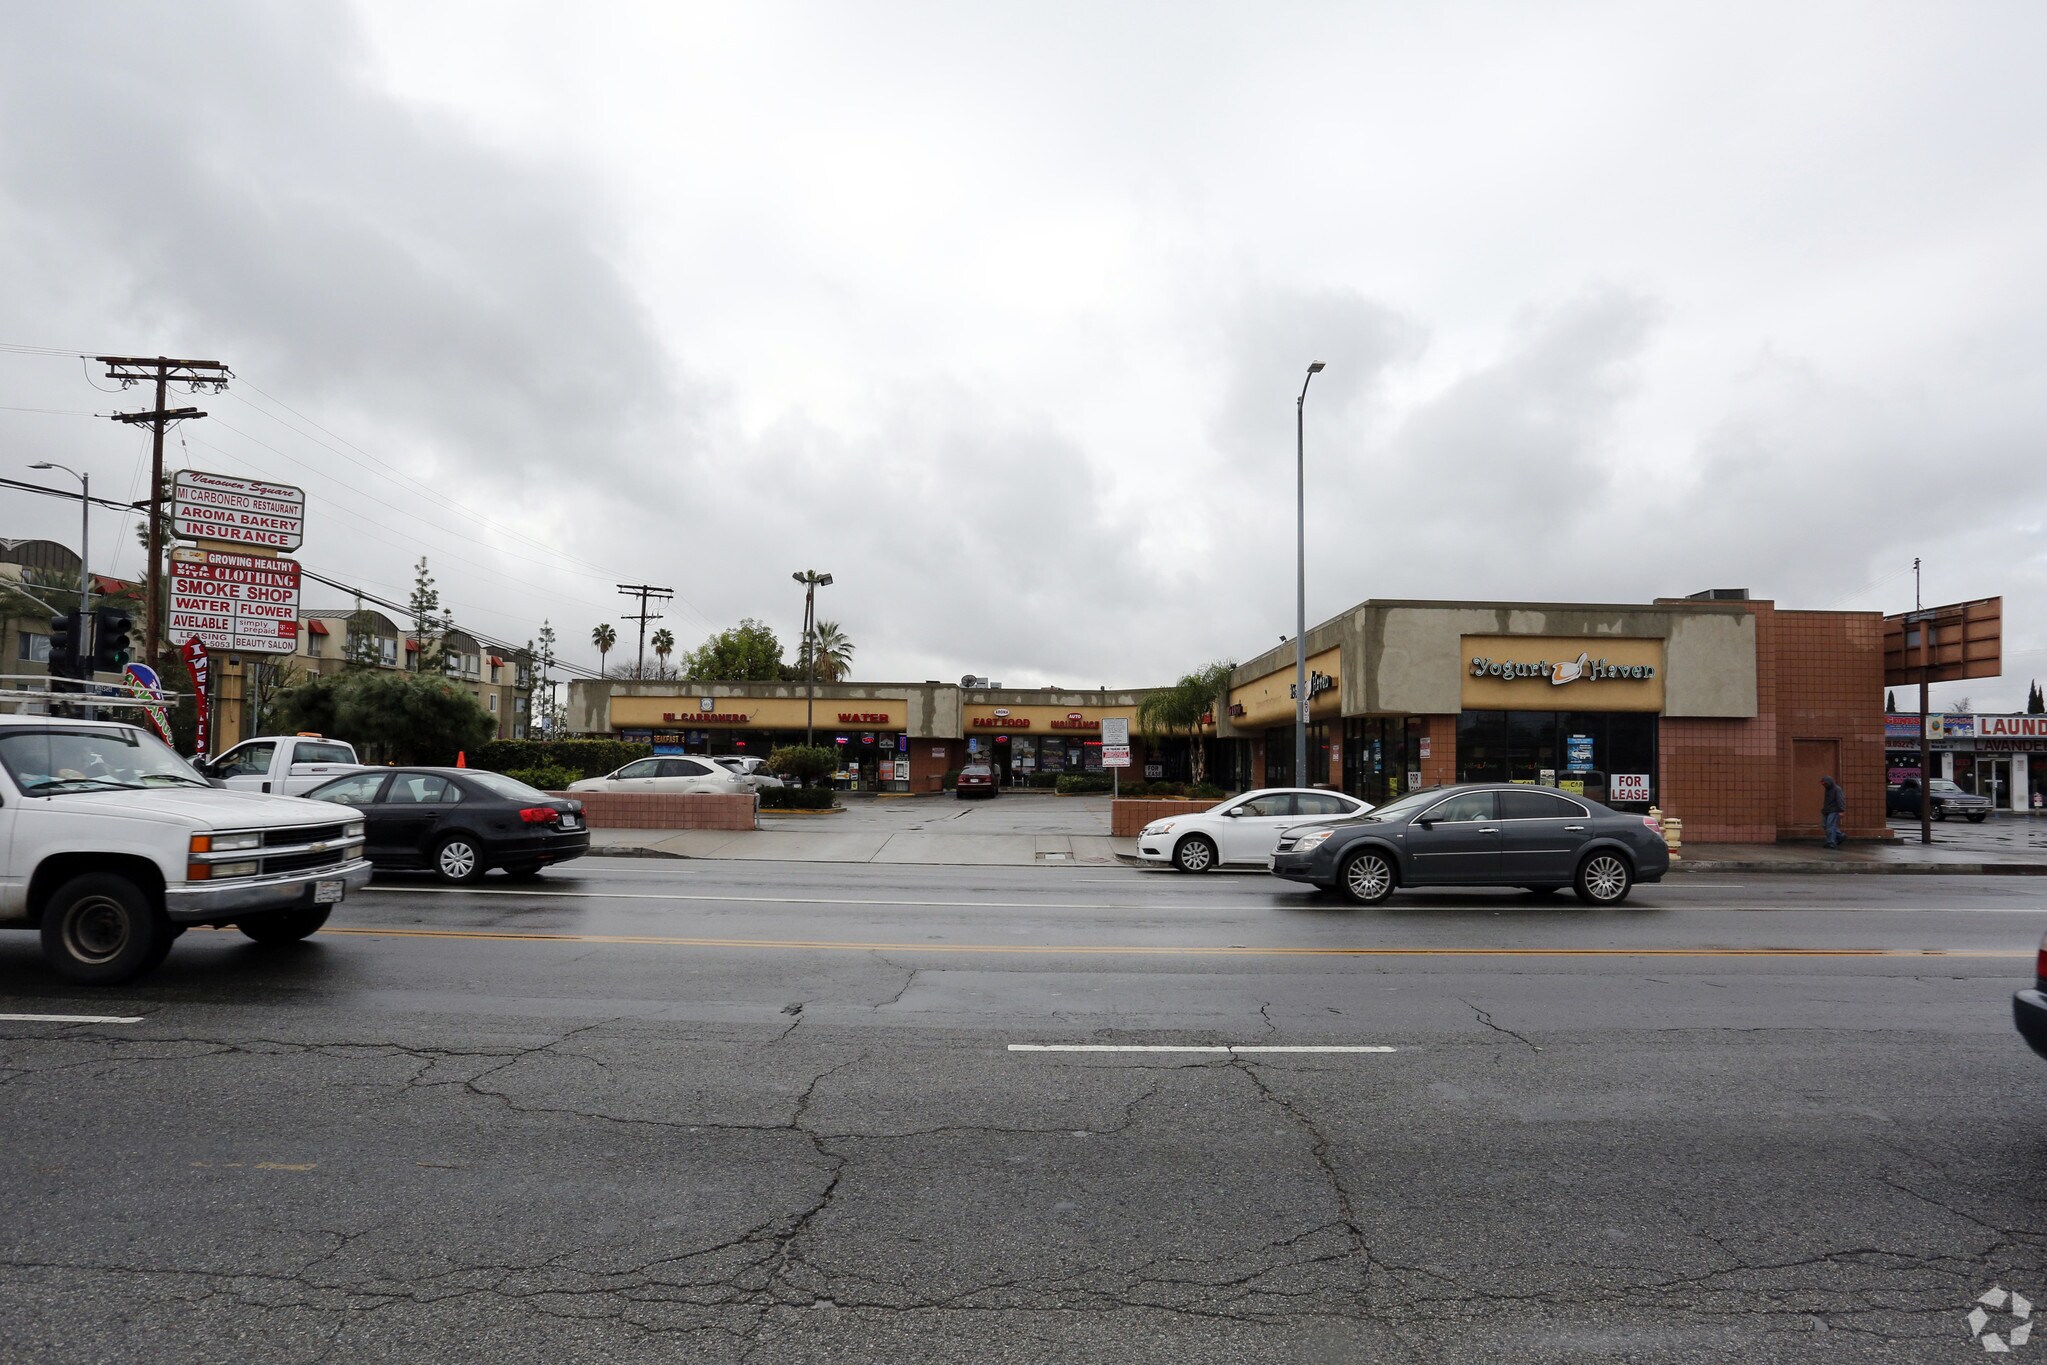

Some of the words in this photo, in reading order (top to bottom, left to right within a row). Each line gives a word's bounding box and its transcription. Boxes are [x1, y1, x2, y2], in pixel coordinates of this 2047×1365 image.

[190, 472, 245, 489] Vanowen
[249, 482, 294, 497] Square
[177, 488, 188, 499] MI
[190, 489, 250, 508] CARBONERO
[253, 500, 298, 515] RESTAURANT
[181, 506, 236, 522] AROMA
[240, 514, 298, 530] BAKERY
[186, 522, 288, 545] INSURANCE
[208, 554, 252, 568] GROWING
[254, 560, 294, 572] HEALTHY
[176, 568, 210, 577] Style
[214, 568, 294, 587] CLOTHING
[176, 579, 240, 598] SMOKE
[247, 586, 292, 602] SHOP
[176, 598, 230, 612] WATER
[240, 604, 292, 618] FLOWER
[173, 614, 228, 630] AVELABLE
[240, 620, 268, 628] simply
[180, 632, 227, 640] LEASING
[244, 626, 276, 634] prepaid
[236, 638, 266, 648] BEAUTY
[268, 640, 294, 650] SALON
[1472, 656, 1549, 680] Yogurt
[1590, 658, 1656, 682] Haven
[663, 712, 676, 722] MI
[681, 713, 748, 722] CARBONERO
[838, 713, 889, 724] WATER
[973, 718, 999, 728] FAST
[1002, 718, 1030, 728] FOOD
[1050, 720, 1100, 730] INSURANCE
[1974, 740, 2047, 751] LAVANDE
[1618, 776, 1642, 787] FOR
[1612, 789, 1648, 800] LEASE
